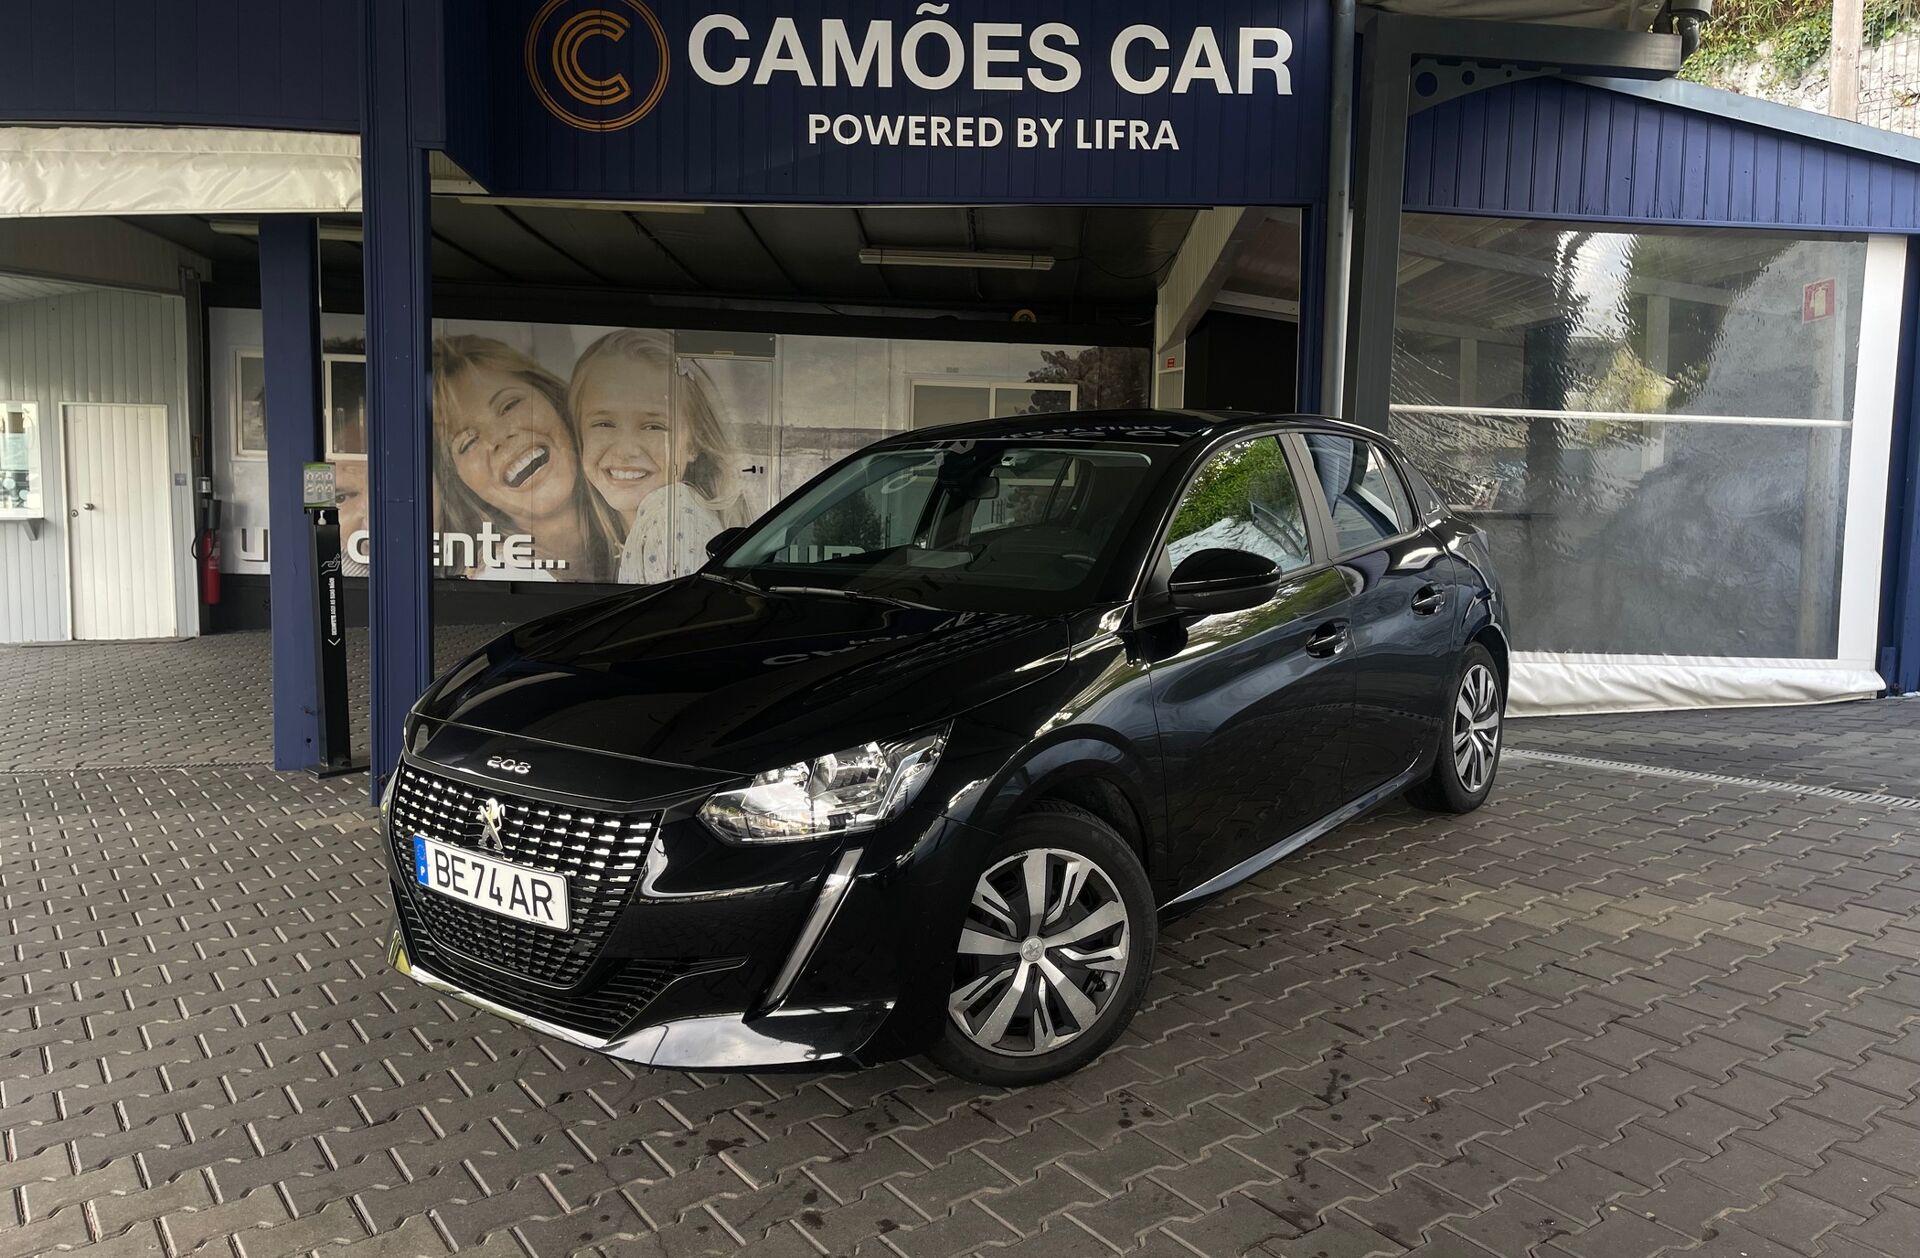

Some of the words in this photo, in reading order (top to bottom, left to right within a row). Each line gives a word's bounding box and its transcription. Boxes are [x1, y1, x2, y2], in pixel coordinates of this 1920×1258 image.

[688, 2, 1082, 93] CAMÕES
[1110, 25, 1293, 95] CAR
[808, 113, 1004, 148] POWERED
[1017, 117, 1064, 149] BY
[1076, 118, 1180, 151] LIFRA
[486, 755, 532, 775] 208
